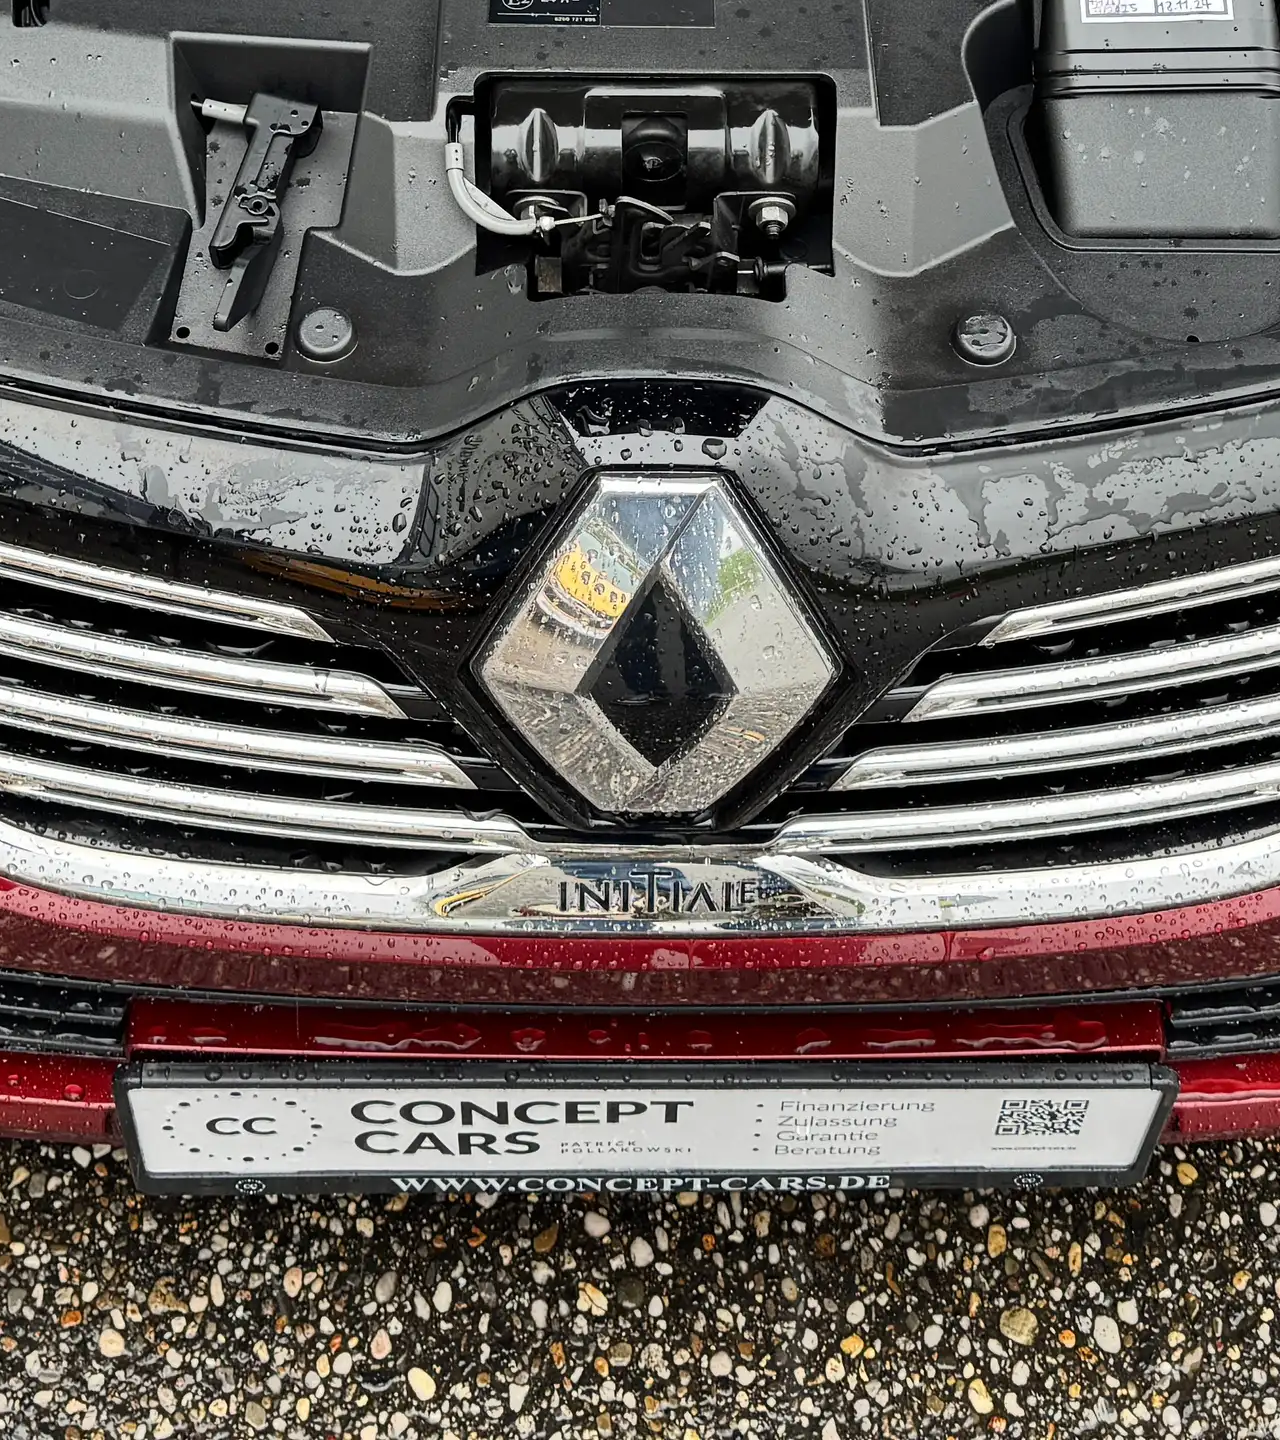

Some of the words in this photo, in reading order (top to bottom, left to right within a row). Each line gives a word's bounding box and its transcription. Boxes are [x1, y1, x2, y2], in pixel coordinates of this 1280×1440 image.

[559, 870, 757, 913] INITIALE
[350, 1100, 694, 1126] CONCEPT
[780, 1101, 935, 1112] Finanzierung
[206, 1117, 278, 1135] CC
[778, 1115, 897, 1127] Zulassung
[354, 1131, 540, 1156] CARS
[776, 1130, 879, 1141] Garantie
[774, 1145, 881, 1156] Beratung
[391, 1175, 890, 1192] WWW.CONCEPT-CARS.DE
